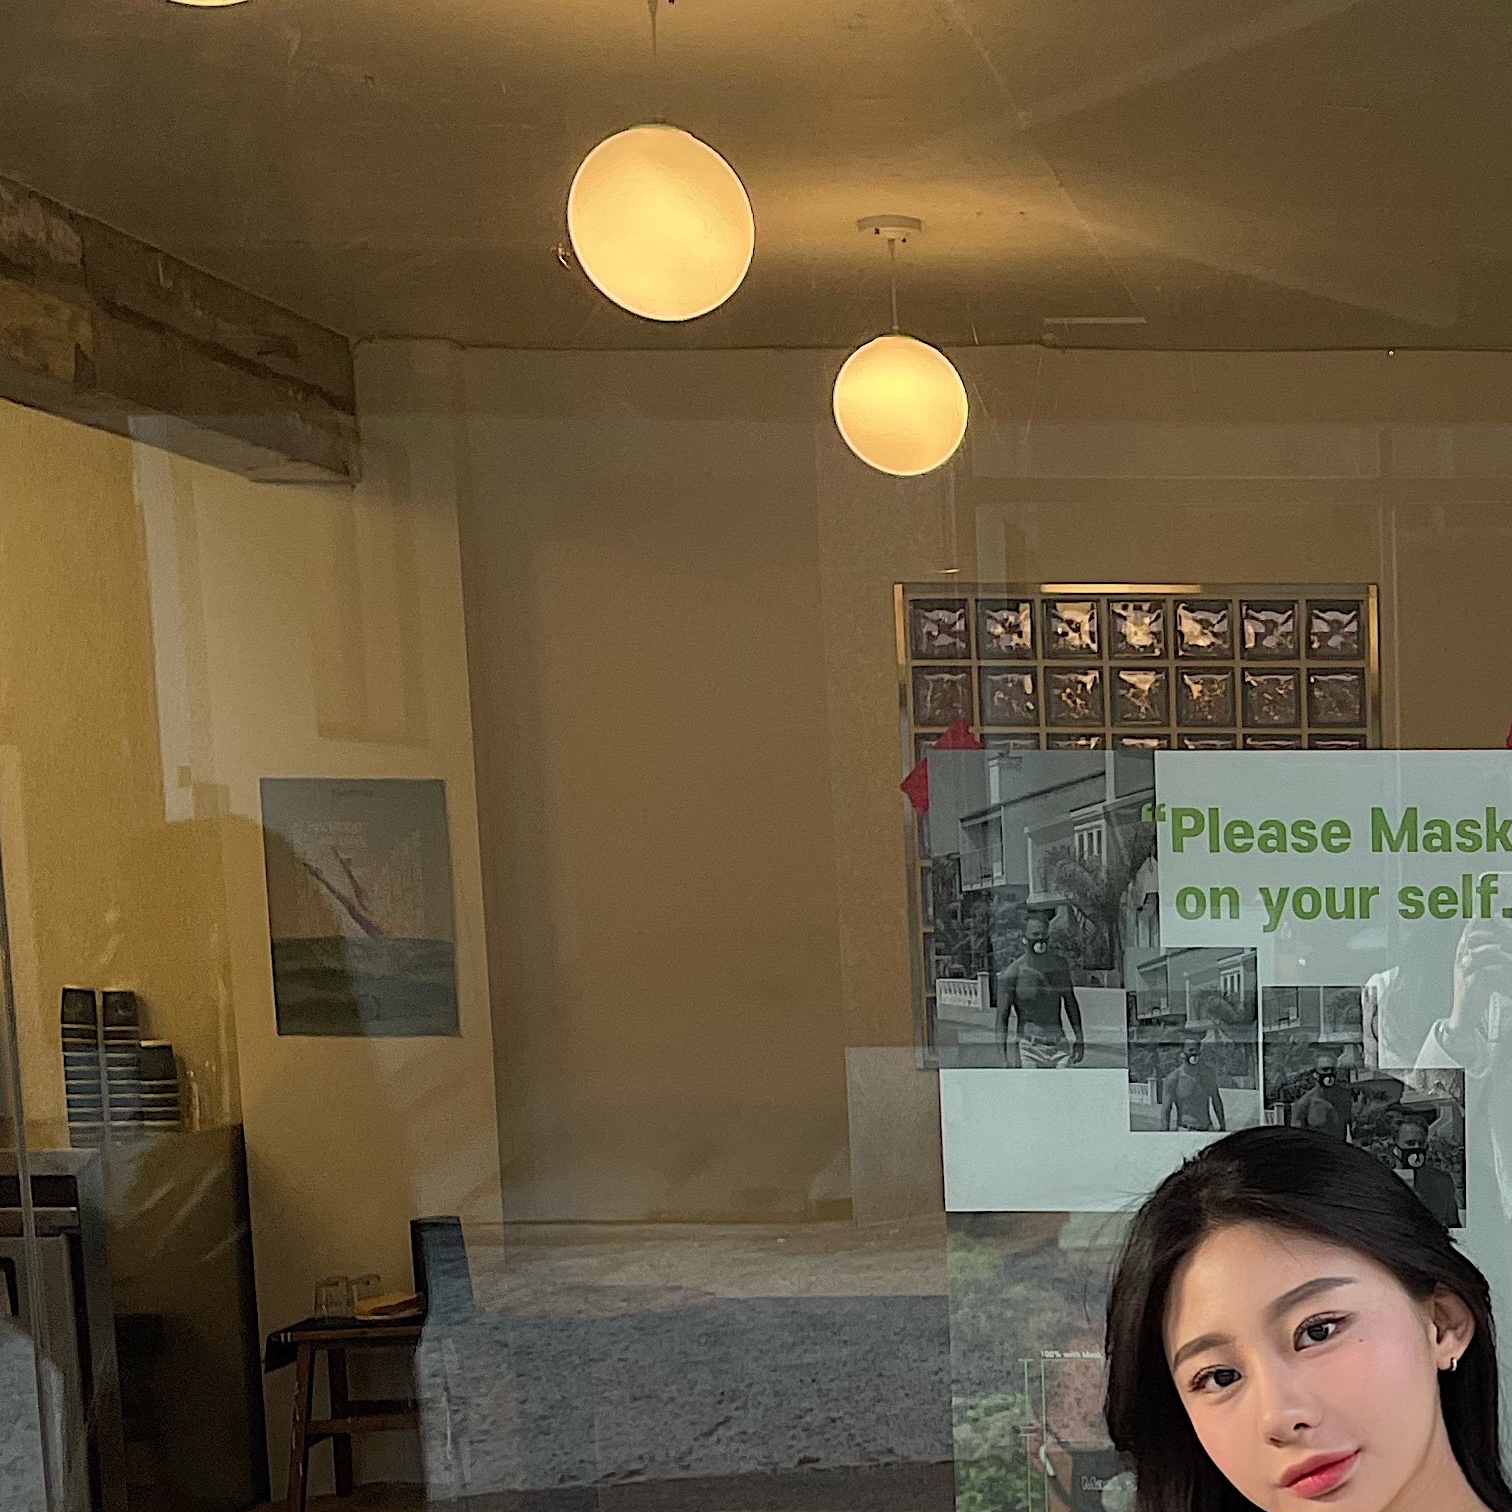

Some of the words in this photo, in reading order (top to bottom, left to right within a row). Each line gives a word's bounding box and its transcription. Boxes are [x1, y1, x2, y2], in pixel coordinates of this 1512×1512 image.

[1140, 802, 1352, 854] “Please
[1175, 885, 1241, 917] on
[1260, 885, 1381, 932] your
